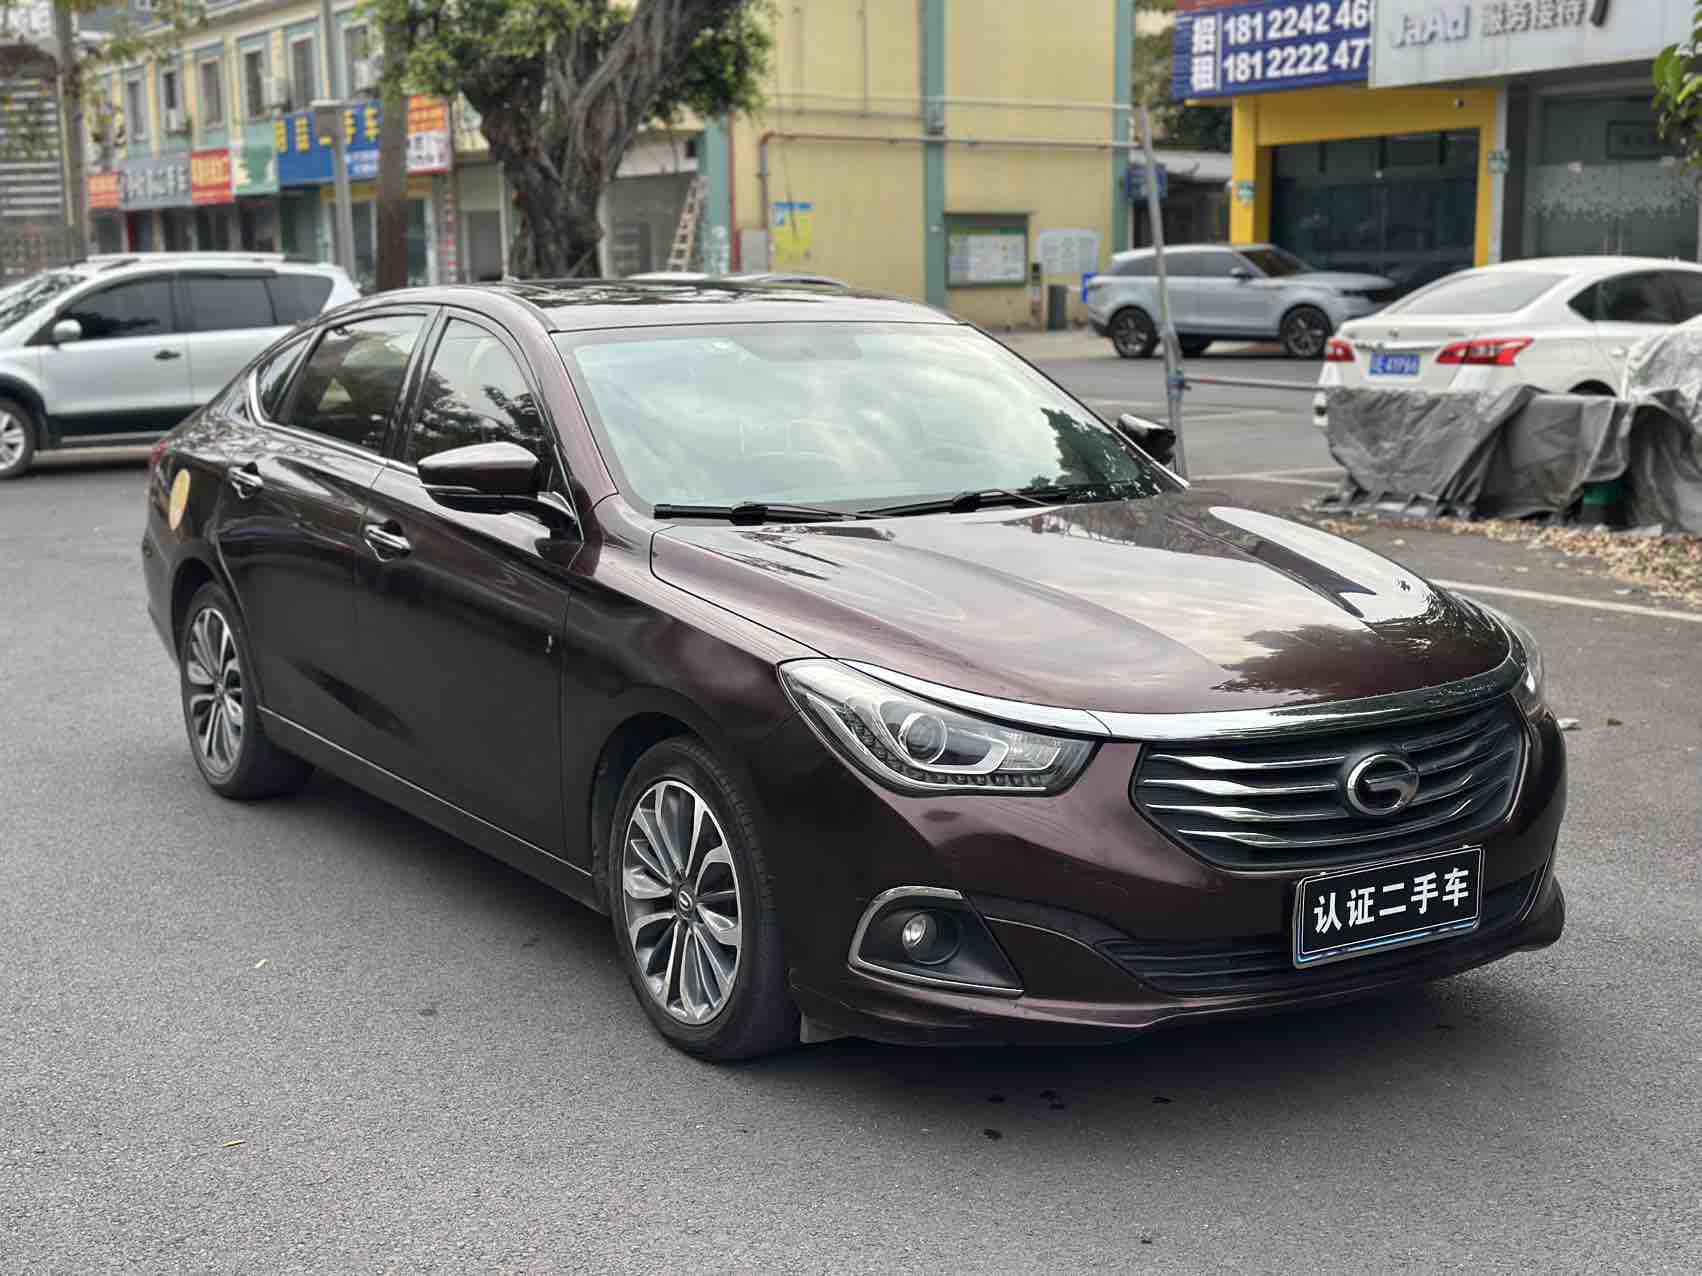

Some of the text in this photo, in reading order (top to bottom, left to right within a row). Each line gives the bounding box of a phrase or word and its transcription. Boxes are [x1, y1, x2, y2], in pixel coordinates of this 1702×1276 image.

[1224, 12, 1264, 46] 181
[1267, 2, 1331, 39] 2242
[1223, 37, 1374, 83] 181 2222 47
[1313, 867, 1470, 934] 认证二手车
